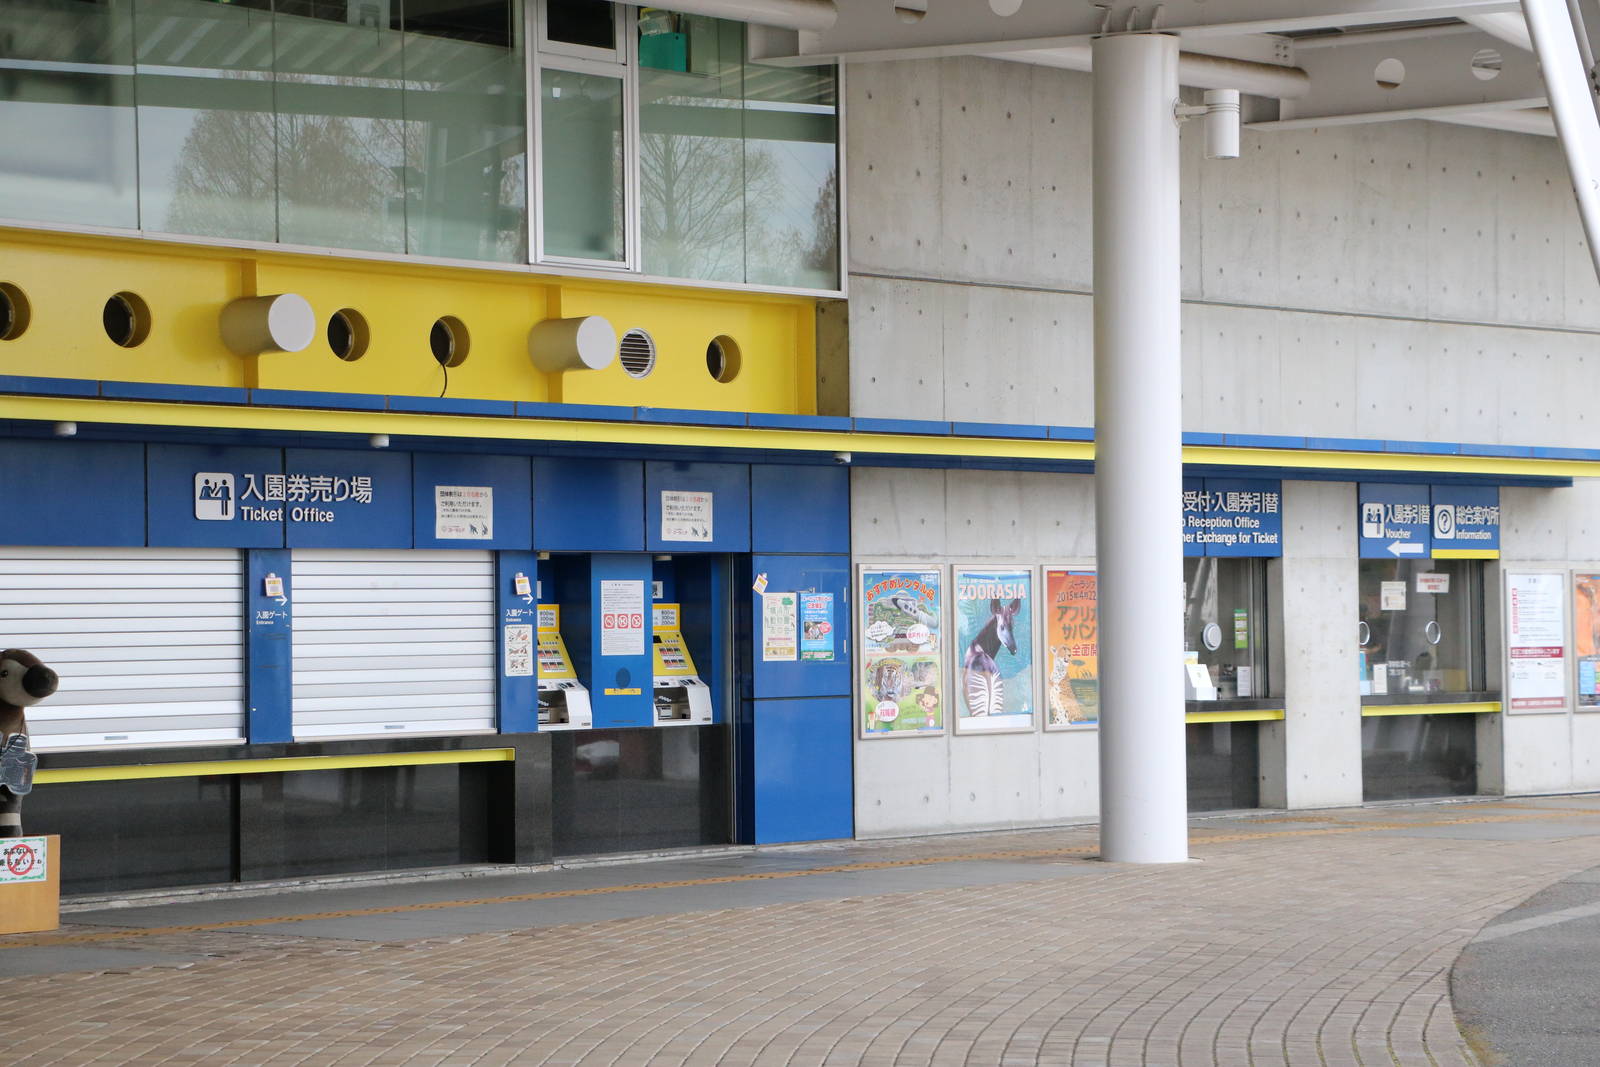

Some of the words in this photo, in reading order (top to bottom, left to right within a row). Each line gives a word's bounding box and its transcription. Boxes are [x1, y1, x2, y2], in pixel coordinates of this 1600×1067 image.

[240, 473, 373, 504] 入園券売り場
[1181, 490, 1279, 514] 受付・入園券引替
[240, 506, 284, 522] Ticket
[291, 507, 335, 523] Office
[1188, 515, 1233, 531] Reception
[1234, 516, 1260, 529] Office
[1385, 504, 1430, 525] 入園券引替
[1456, 505, 1499, 525] 総合案内所
[1196, 531, 1237, 546] Exchange
[1238, 532, 1252, 544] for
[1252, 532, 1278, 544] Ticket
[1385, 528, 1411, 539] Voucher
[1455, 529, 1492, 540] Information
[865, 577, 936, 602] おすすめレンタル品
[959, 583, 1026, 600] ZOORASIA
